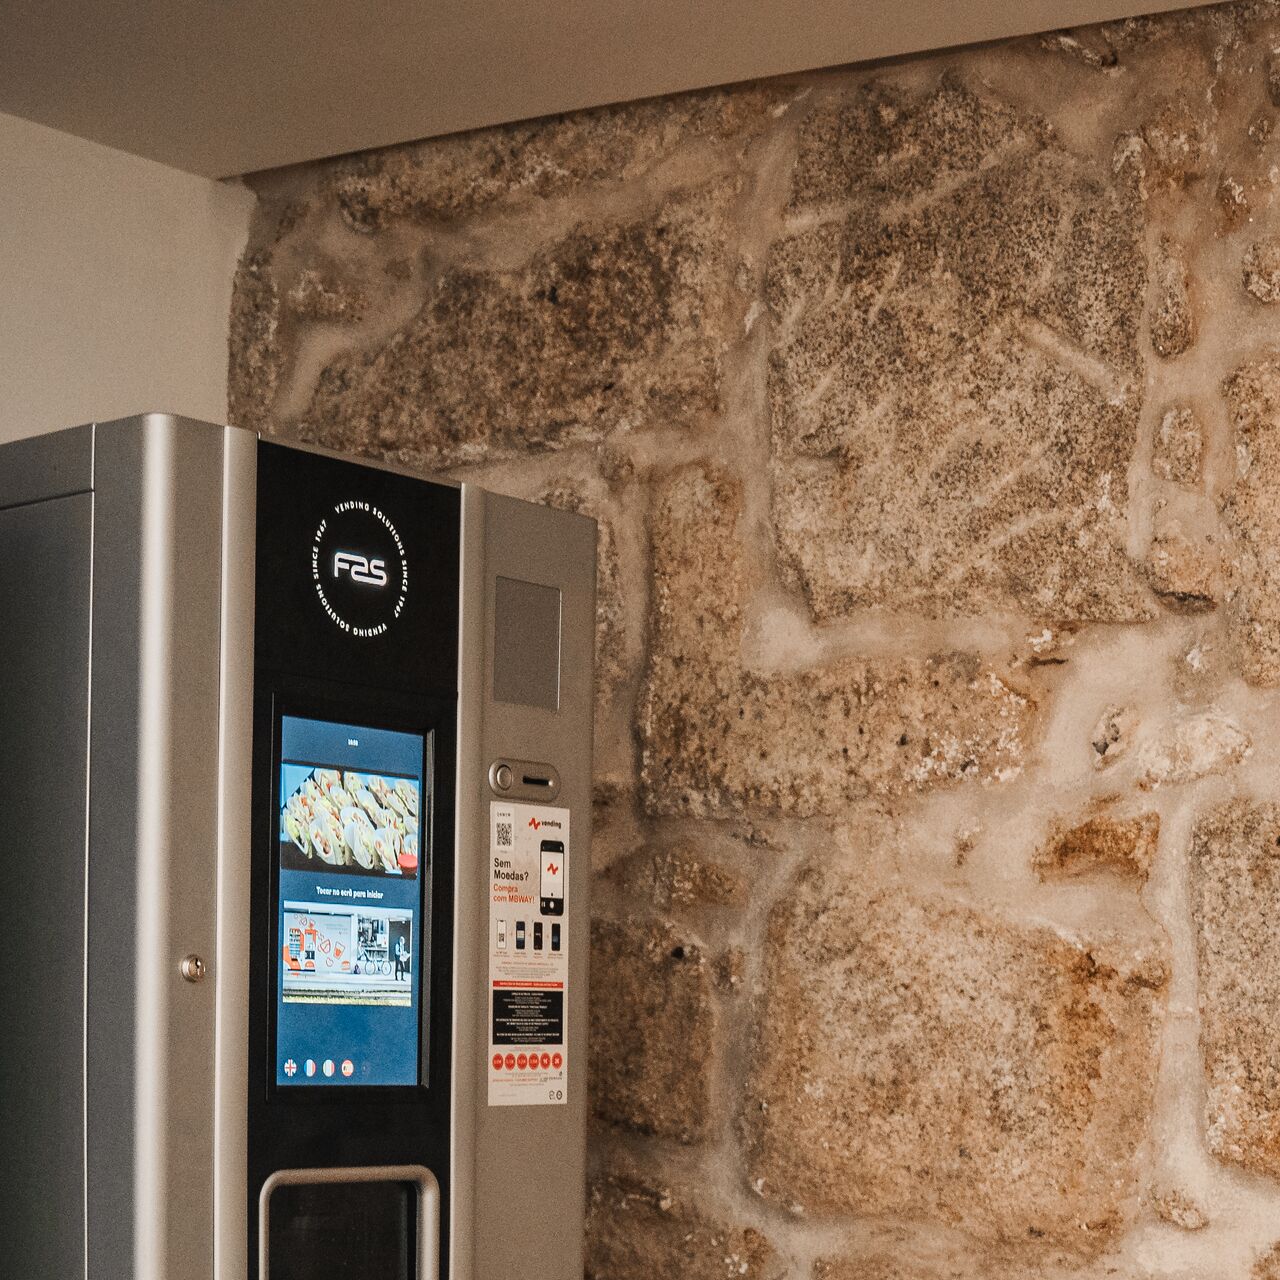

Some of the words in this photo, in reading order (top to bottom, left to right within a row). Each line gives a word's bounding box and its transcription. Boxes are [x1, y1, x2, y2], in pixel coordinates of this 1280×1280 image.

[335, 500, 370, 514] VENDING
[372, 507, 405, 556] SOLUTIONS
[315, 583, 350, 633] SOLUTIONS
[353, 622, 388, 637] VENDING
[541, 820, 562, 830] vending
[494, 857, 512, 868] Sem
[494, 869, 529, 881] Moedas?
[316, 885, 332, 896] Tocar
[332, 888, 339, 896] no
[353, 890, 366, 899] para
[493, 883, 519, 894] Compra
[493, 895, 507, 903] com
[508, 894, 535, 904] MBWAY!
